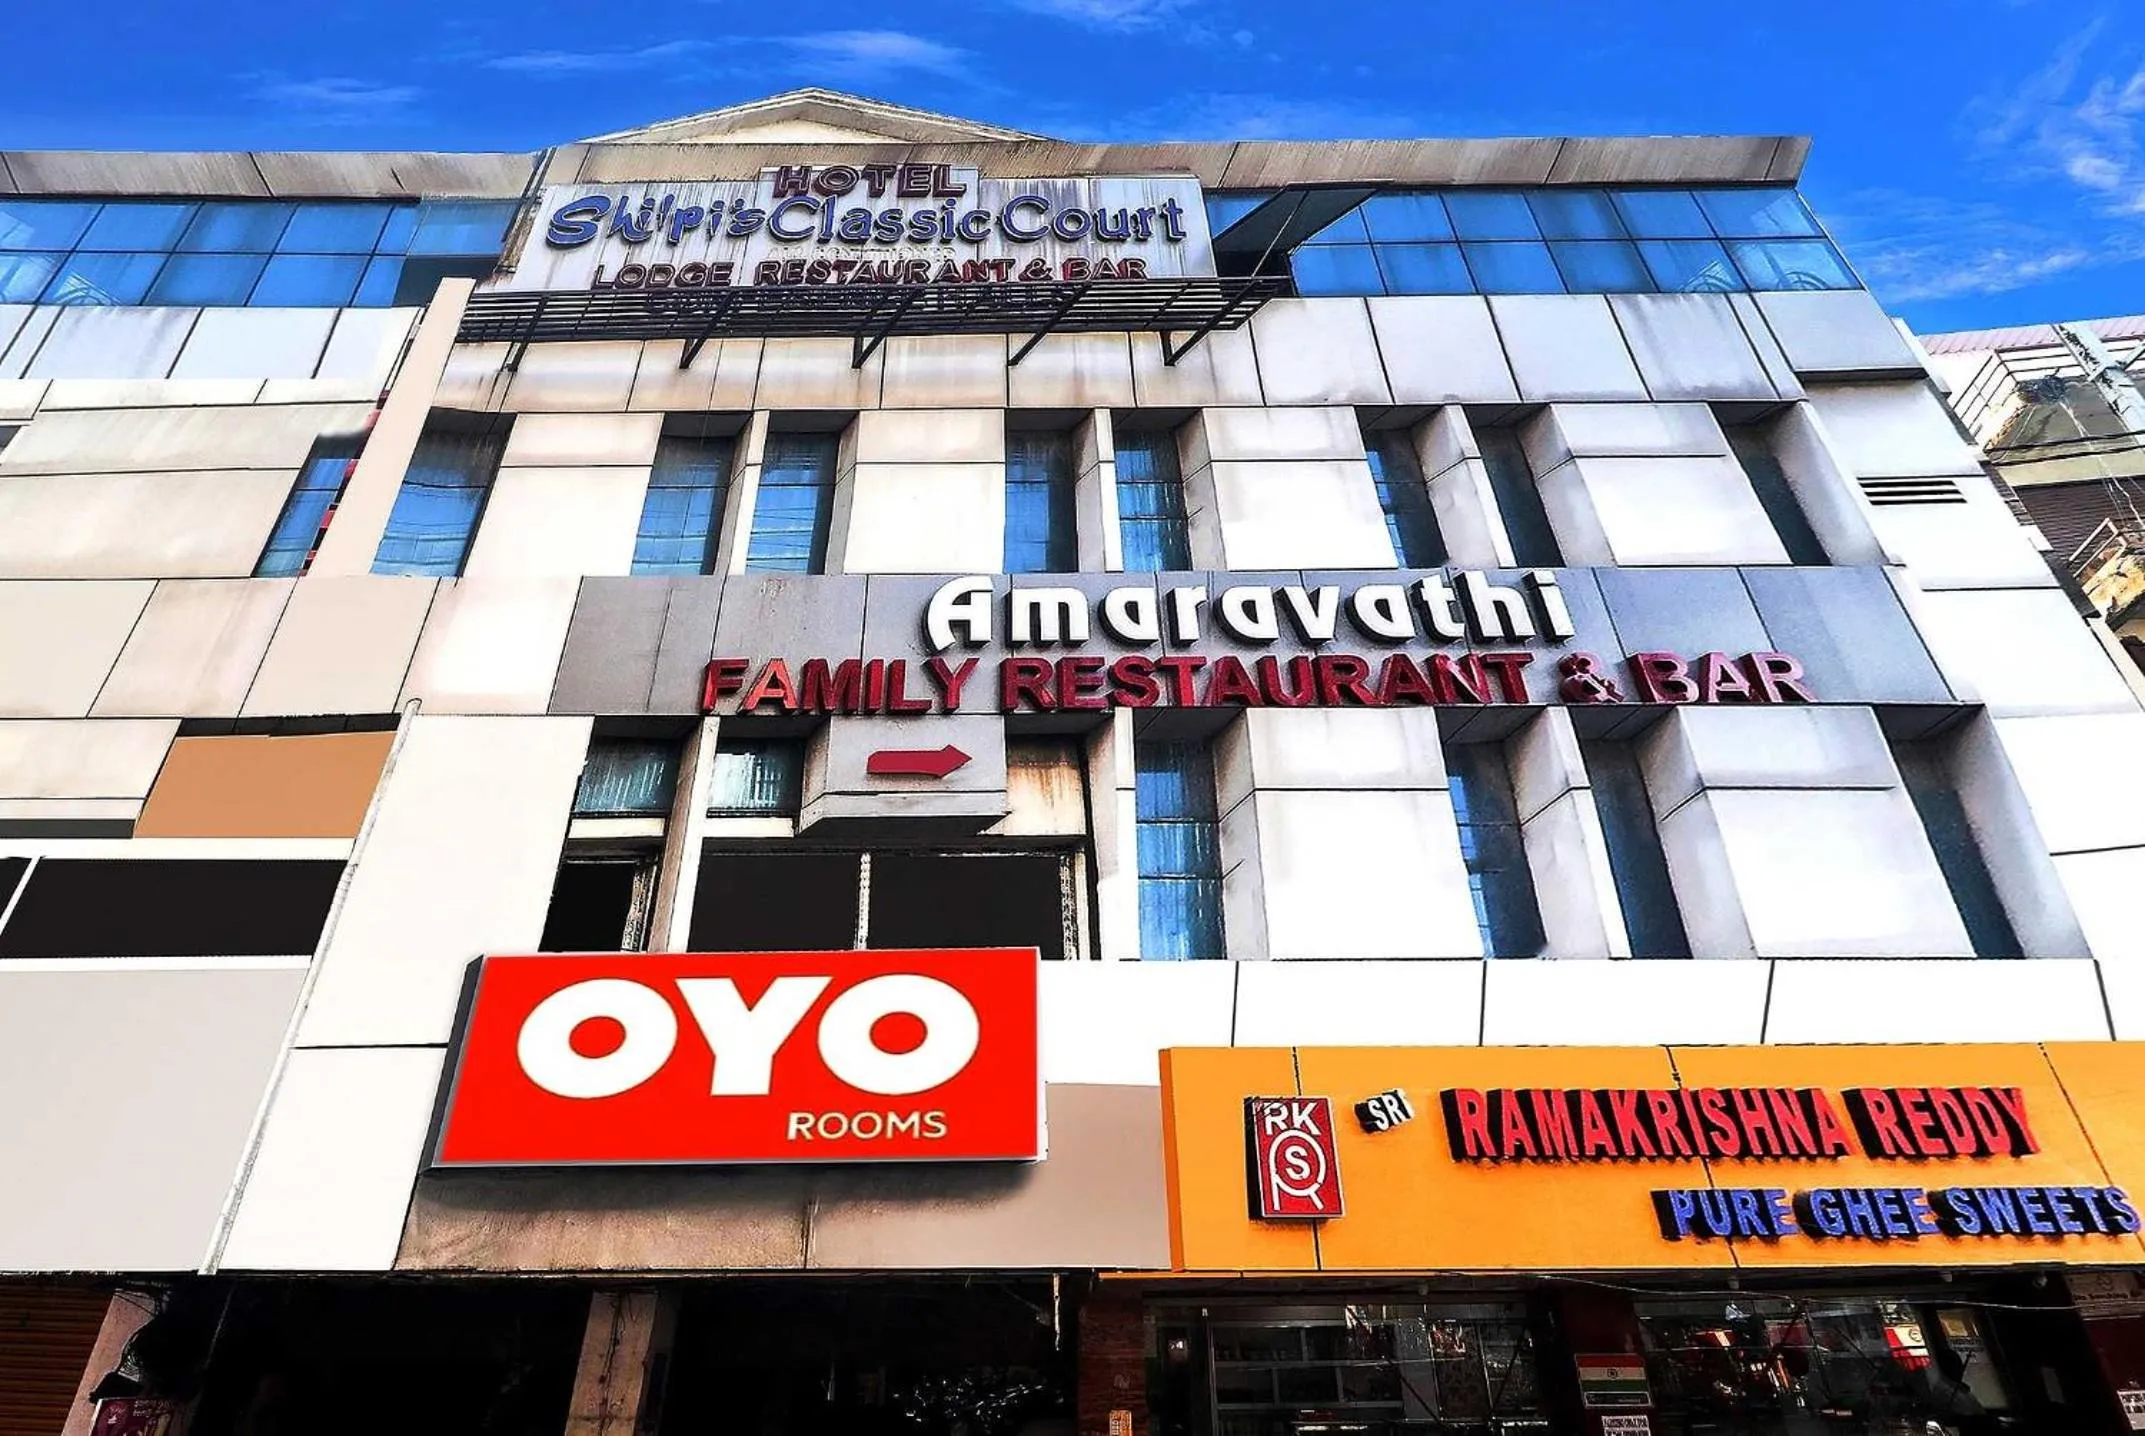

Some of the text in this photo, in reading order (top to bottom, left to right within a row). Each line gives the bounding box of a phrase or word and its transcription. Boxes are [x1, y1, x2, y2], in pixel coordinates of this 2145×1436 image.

[774, 164, 967, 197] HOTEL
[769, 195, 992, 245] Classic
[1002, 195, 1186, 242] Court
[592, 258, 1147, 290] LODGE RESTAURANT & BAR
[925, 572, 1575, 651] Amaravathi
[702, 651, 1820, 713] FAMILY RESTAURANT & BAR
[516, 973, 981, 1099] OYO
[786, 1111, 948, 1140] ROOMS
[1263, 1101, 1321, 1136] RK
[1450, 1088, 1852, 1158] RAMAKRISHNA
[1852, 1088, 2041, 1156] REDDY
[1663, 1186, 2141, 1238] PURE GHEE SWEETS
